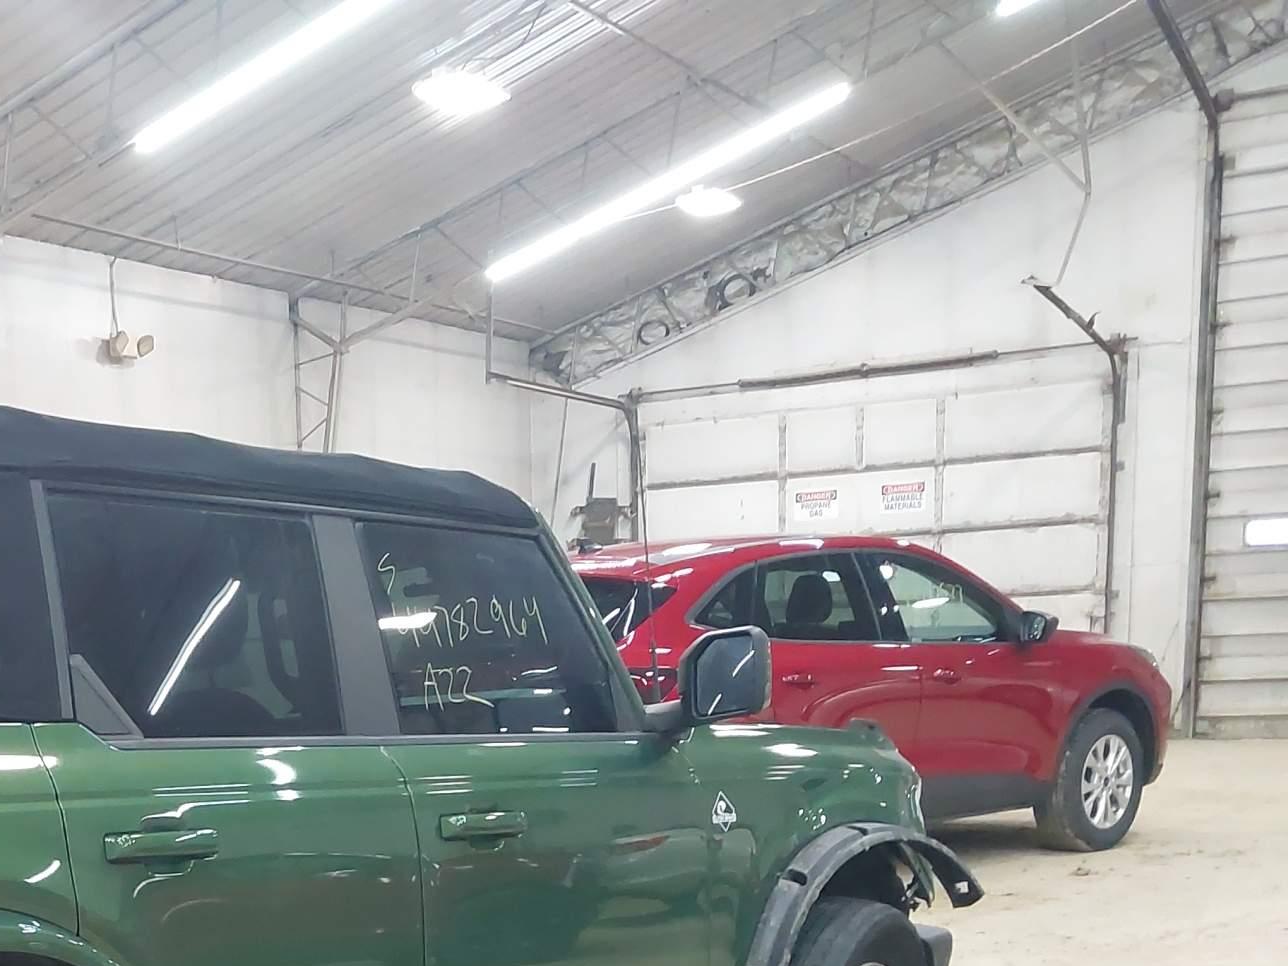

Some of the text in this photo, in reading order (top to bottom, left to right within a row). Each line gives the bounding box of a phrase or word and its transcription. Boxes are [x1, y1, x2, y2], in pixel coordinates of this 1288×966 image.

[887, 483, 919, 495] DANGER
[802, 491, 831, 502] DANGER
[882, 492, 923, 504] FLAMMABLE
[801, 502, 831, 511] PROPANE
[884, 501, 922, 511] MATERIALS
[809, 509, 823, 518] GAS
[423, 662, 495, 712] A22
